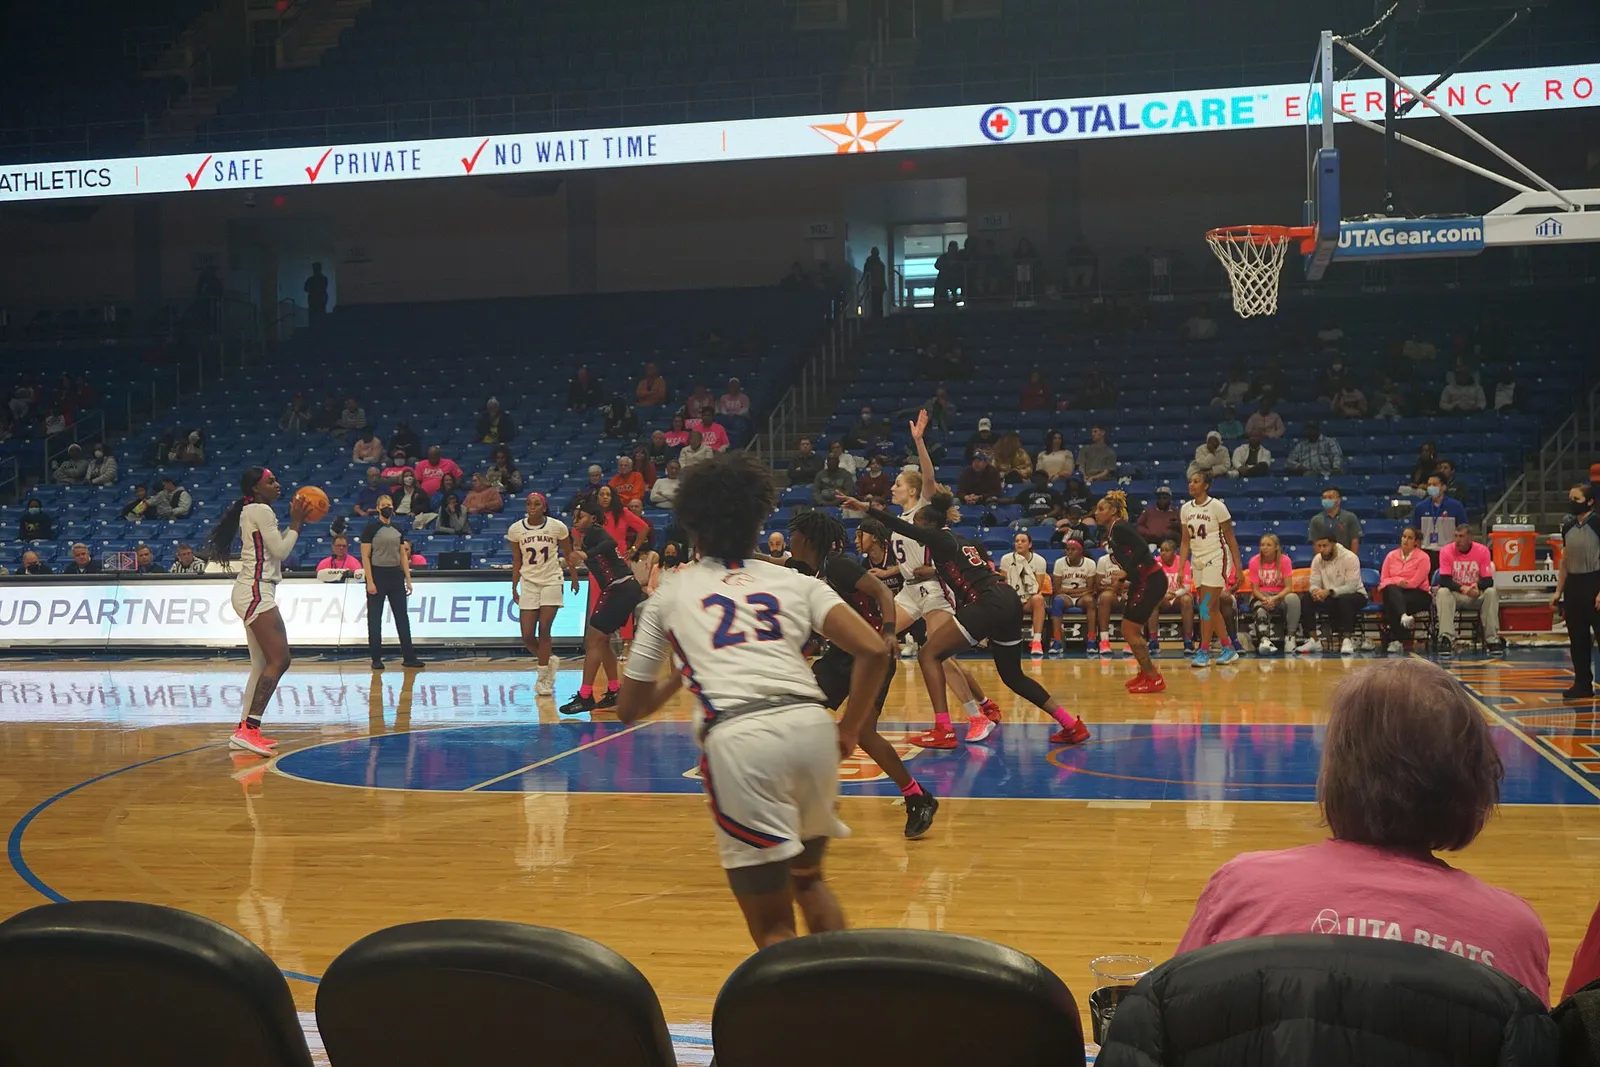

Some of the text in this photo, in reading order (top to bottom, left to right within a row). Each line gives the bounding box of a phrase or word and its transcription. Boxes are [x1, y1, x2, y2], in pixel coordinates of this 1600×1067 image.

[1286, 82, 1520, 117] EERGENCY
[334, 149, 421, 175] PRIVATE
[495, 134, 657, 166] NO WAIT TIME
[0, 168, 112, 192] ATHLETICS
[214, 158, 264, 182] SAFE
[1338, 227, 1481, 248] UTAGear.com
[521, 537, 535, 546] LADY
[1188, 524, 1207, 539] 24
[526, 547, 549, 564] 21
[1505, 540, 1518, 554] G
[1453, 561, 1479, 571] UTA
[1512, 574, 1557, 583] GATORA
[48, 598, 211, 625] PARTNER
[276, 597, 348, 625] UTA
[701, 592, 784, 650] 23
[1413, 928, 1495, 967] BEATS
